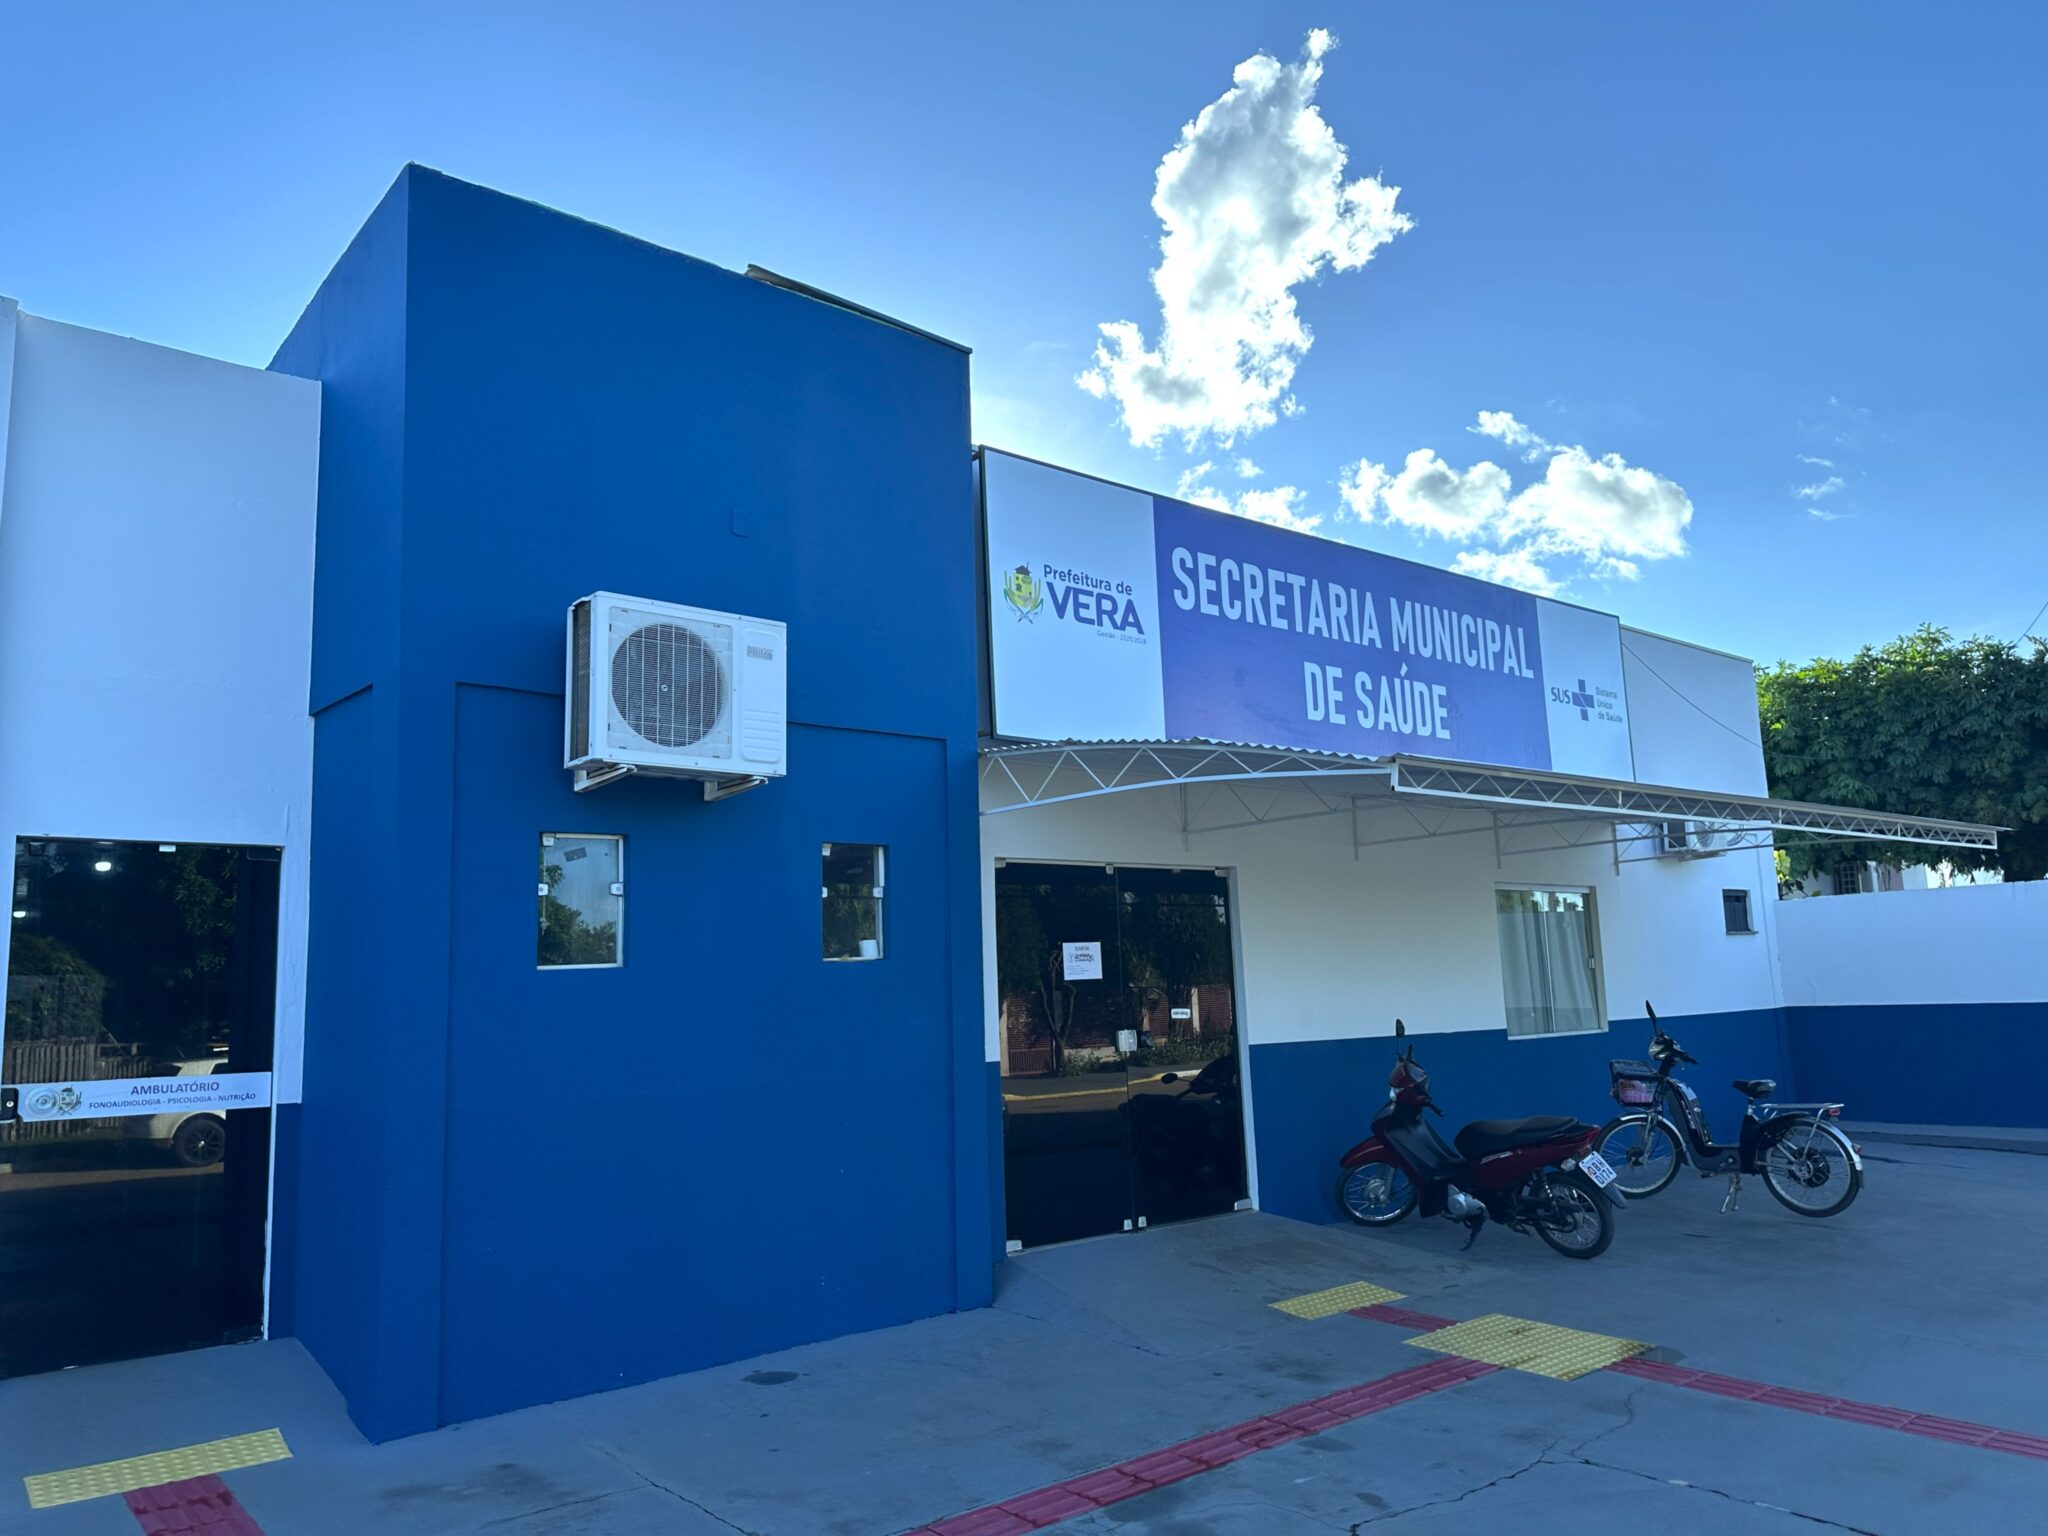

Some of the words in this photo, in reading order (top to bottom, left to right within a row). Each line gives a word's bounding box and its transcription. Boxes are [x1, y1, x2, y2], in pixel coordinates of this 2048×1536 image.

[1043, 563, 1112, 592] Prefeitura
[1116, 581, 1133, 596] de
[1046, 581, 1145, 635] VERA
[1172, 547, 1382, 648] SECRETARIA
[1390, 597, 1534, 679] MUNICIPAL
[1304, 661, 1346, 726] DE
[1354, 662, 1451, 740] SAÚDE
[1551, 686, 1571, 705] SUS
[1595, 686, 1618, 699] Sistema
[89, 1098, 161, 1110] FONOAUDIOLOGIA
[167, 1096, 213, 1105] PSICOLOGIA
[218, 1092, 256, 1102] NUTRIÇÃO
[131, 1081, 220, 1096] AMBULATÓRIO
